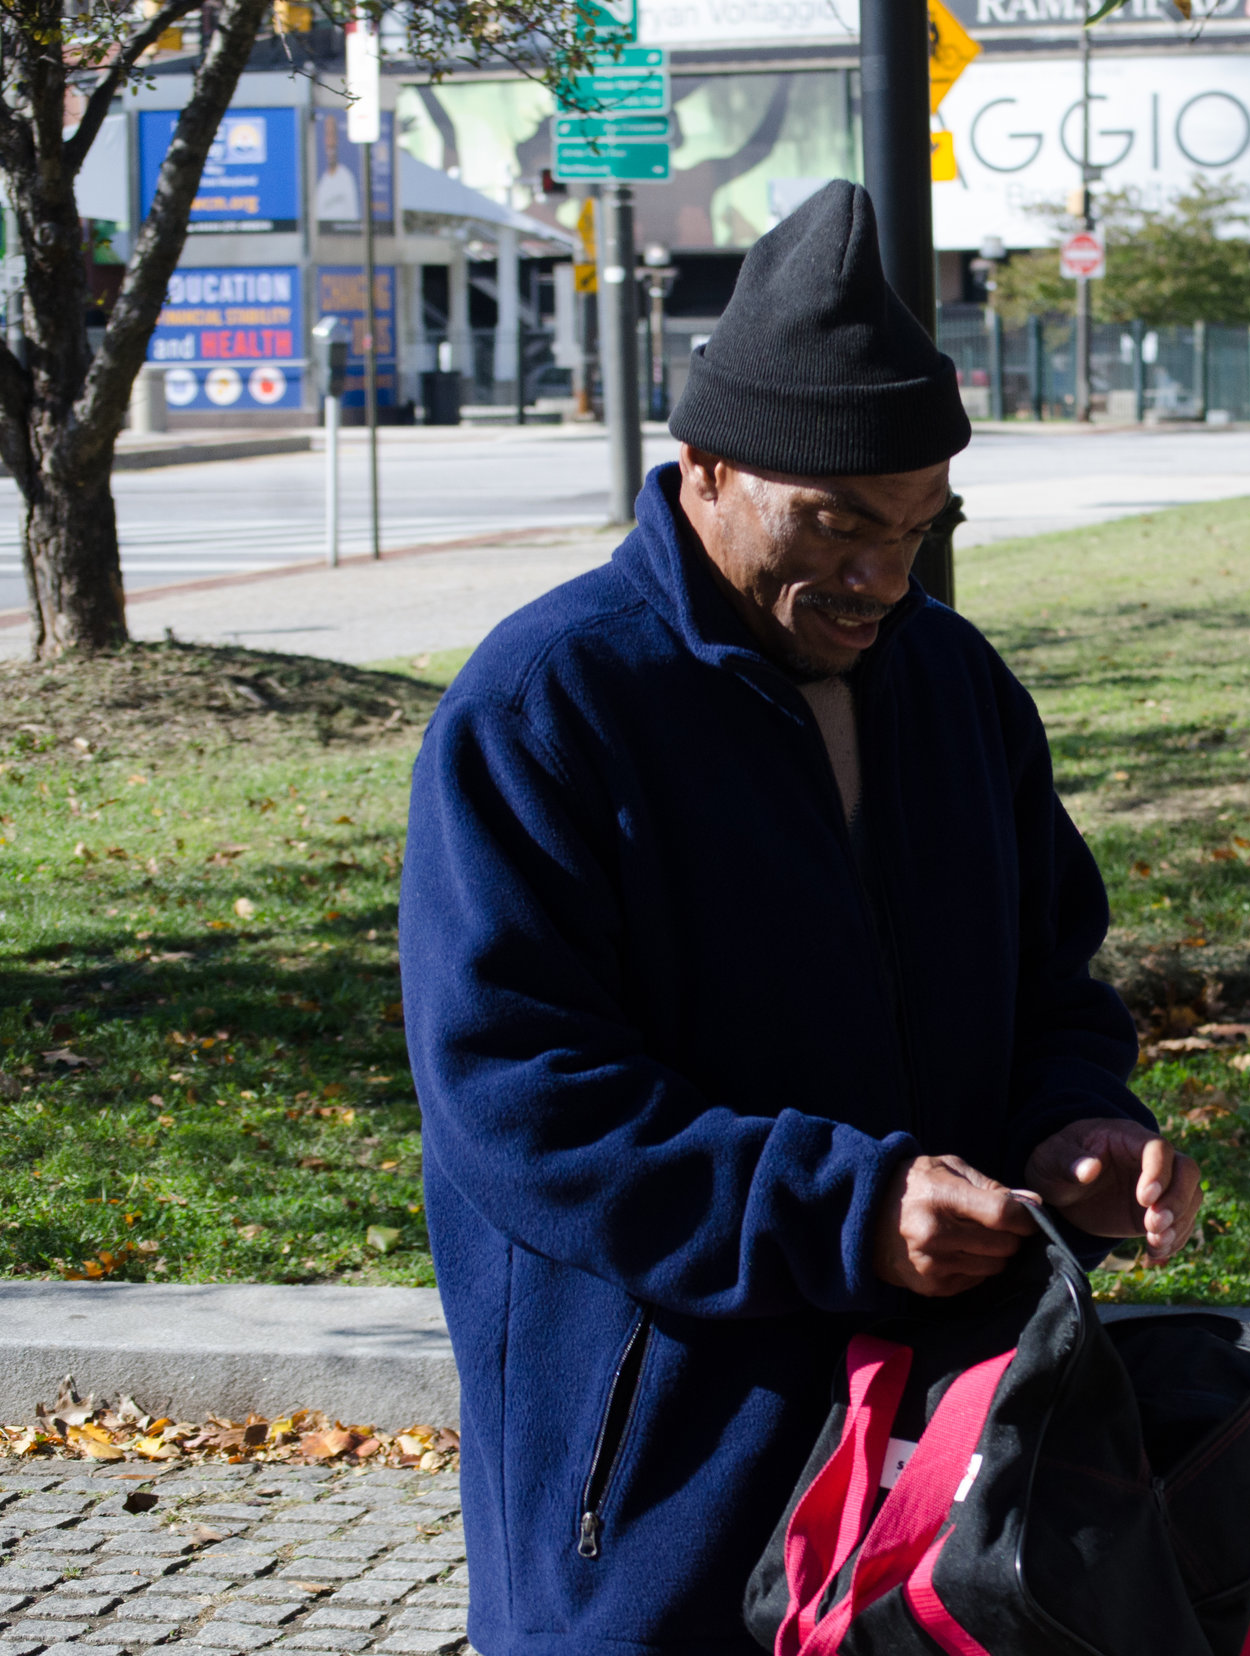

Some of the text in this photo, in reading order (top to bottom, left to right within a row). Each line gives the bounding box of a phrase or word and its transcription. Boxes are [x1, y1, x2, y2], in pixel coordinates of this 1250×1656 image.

[168, 273, 292, 304] DUCATION
[157, 307, 222, 327] INANCIAL
[153, 330, 292, 360] and HEALTH
